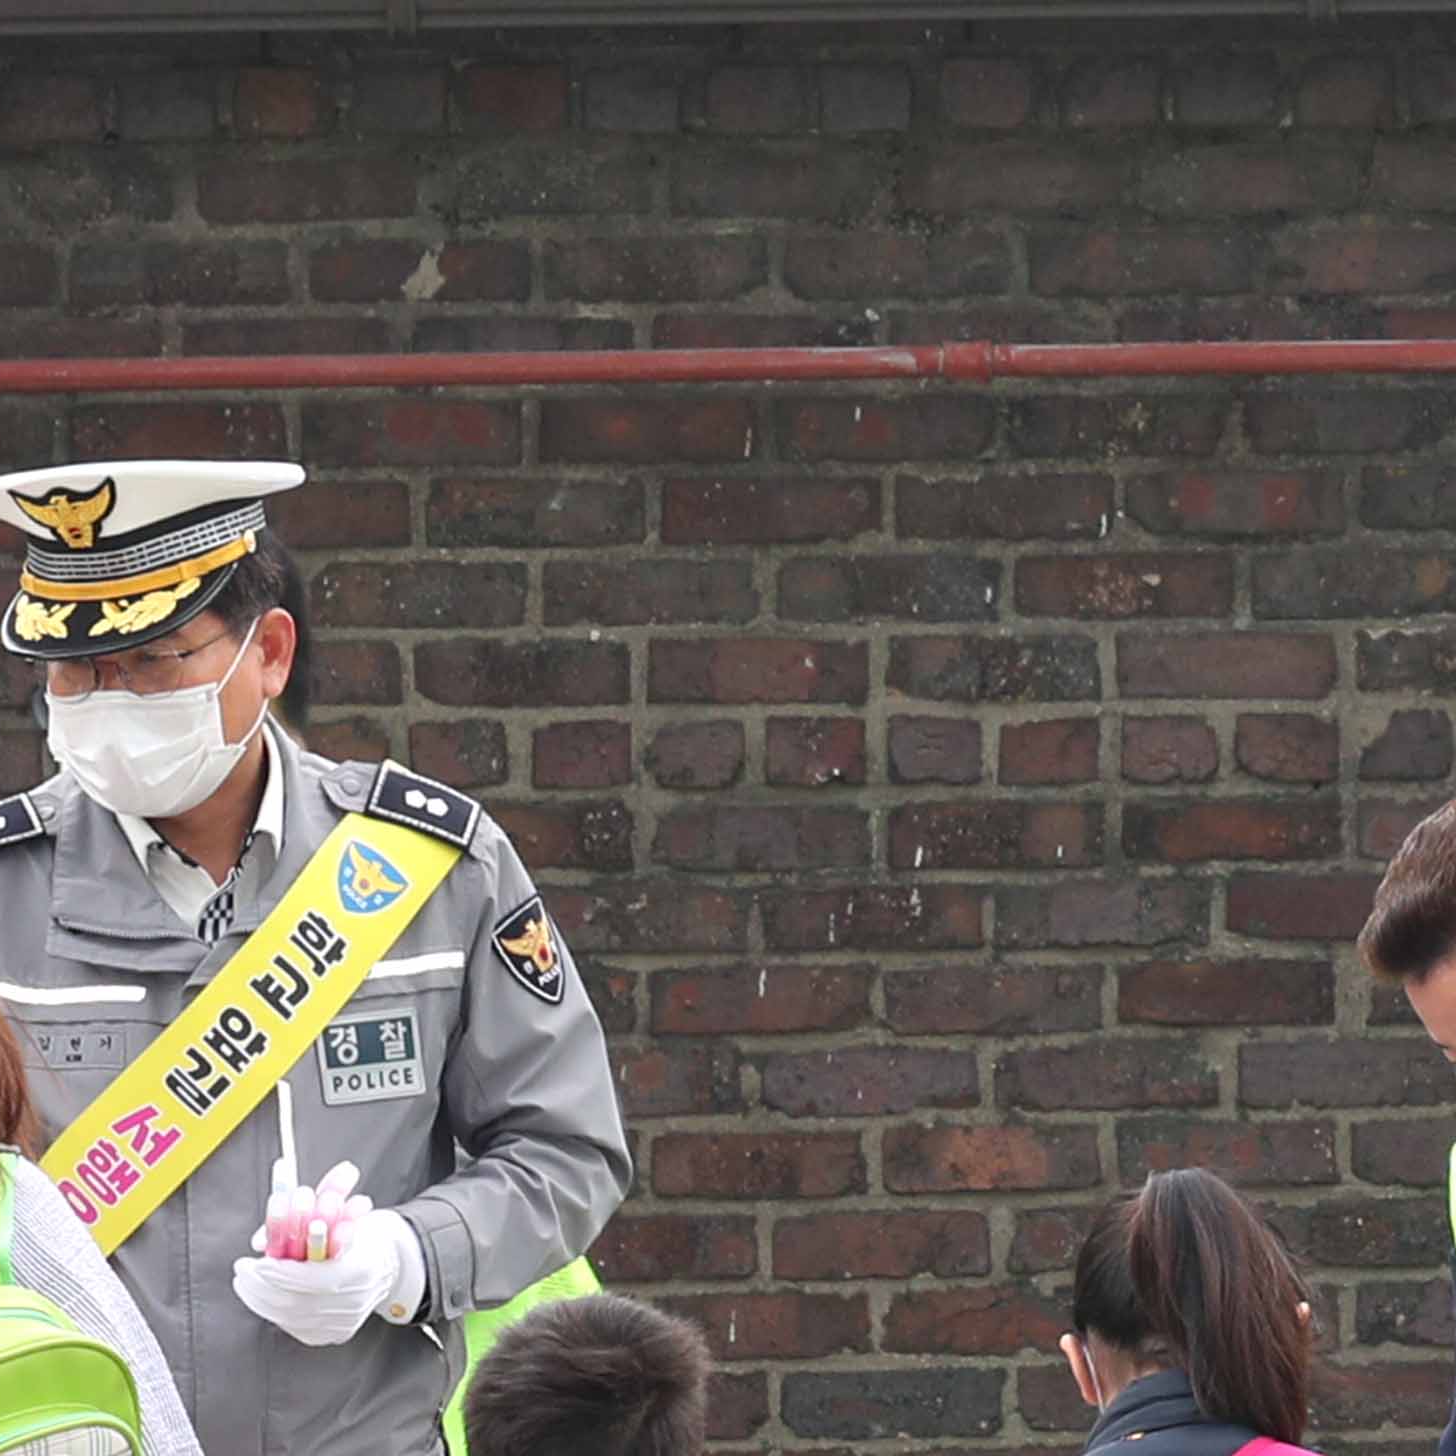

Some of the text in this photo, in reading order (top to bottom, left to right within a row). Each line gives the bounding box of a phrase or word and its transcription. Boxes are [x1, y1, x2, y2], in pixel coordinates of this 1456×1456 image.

[250, 911, 347, 1020] 학교
[164, 1006, 269, 1116] 앞길
[328, 1020, 408, 1065] 경찰
[331, 1067, 415, 1094] POLICE
